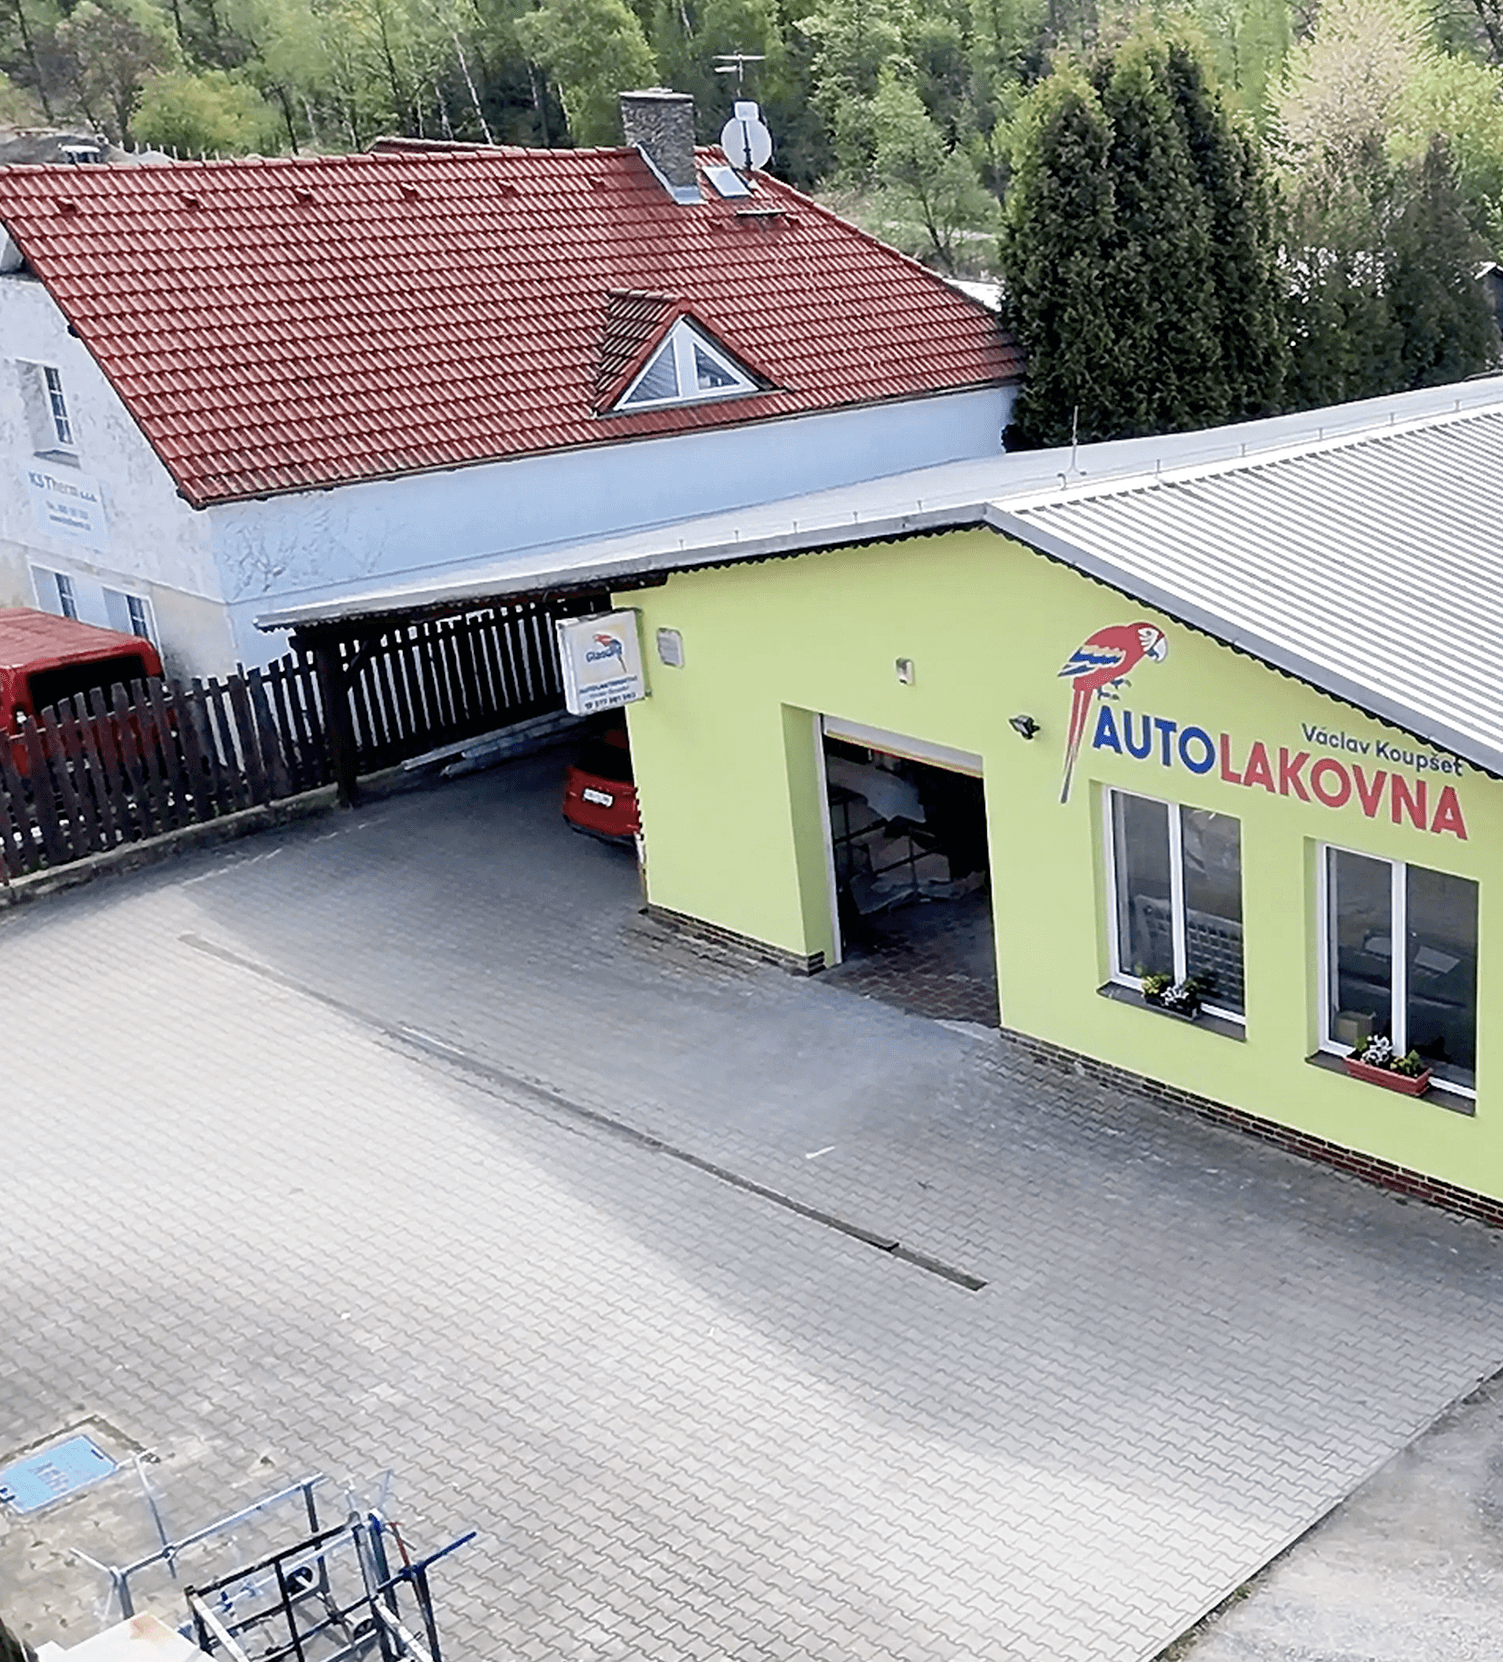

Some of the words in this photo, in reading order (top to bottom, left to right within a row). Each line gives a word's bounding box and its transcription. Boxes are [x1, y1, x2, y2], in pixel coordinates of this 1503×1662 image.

[1092, 704, 1468, 841] AUTOLAKOVNA
[1301, 722, 1371, 755] Václav
[1375, 740, 1464, 777] Koupšet
